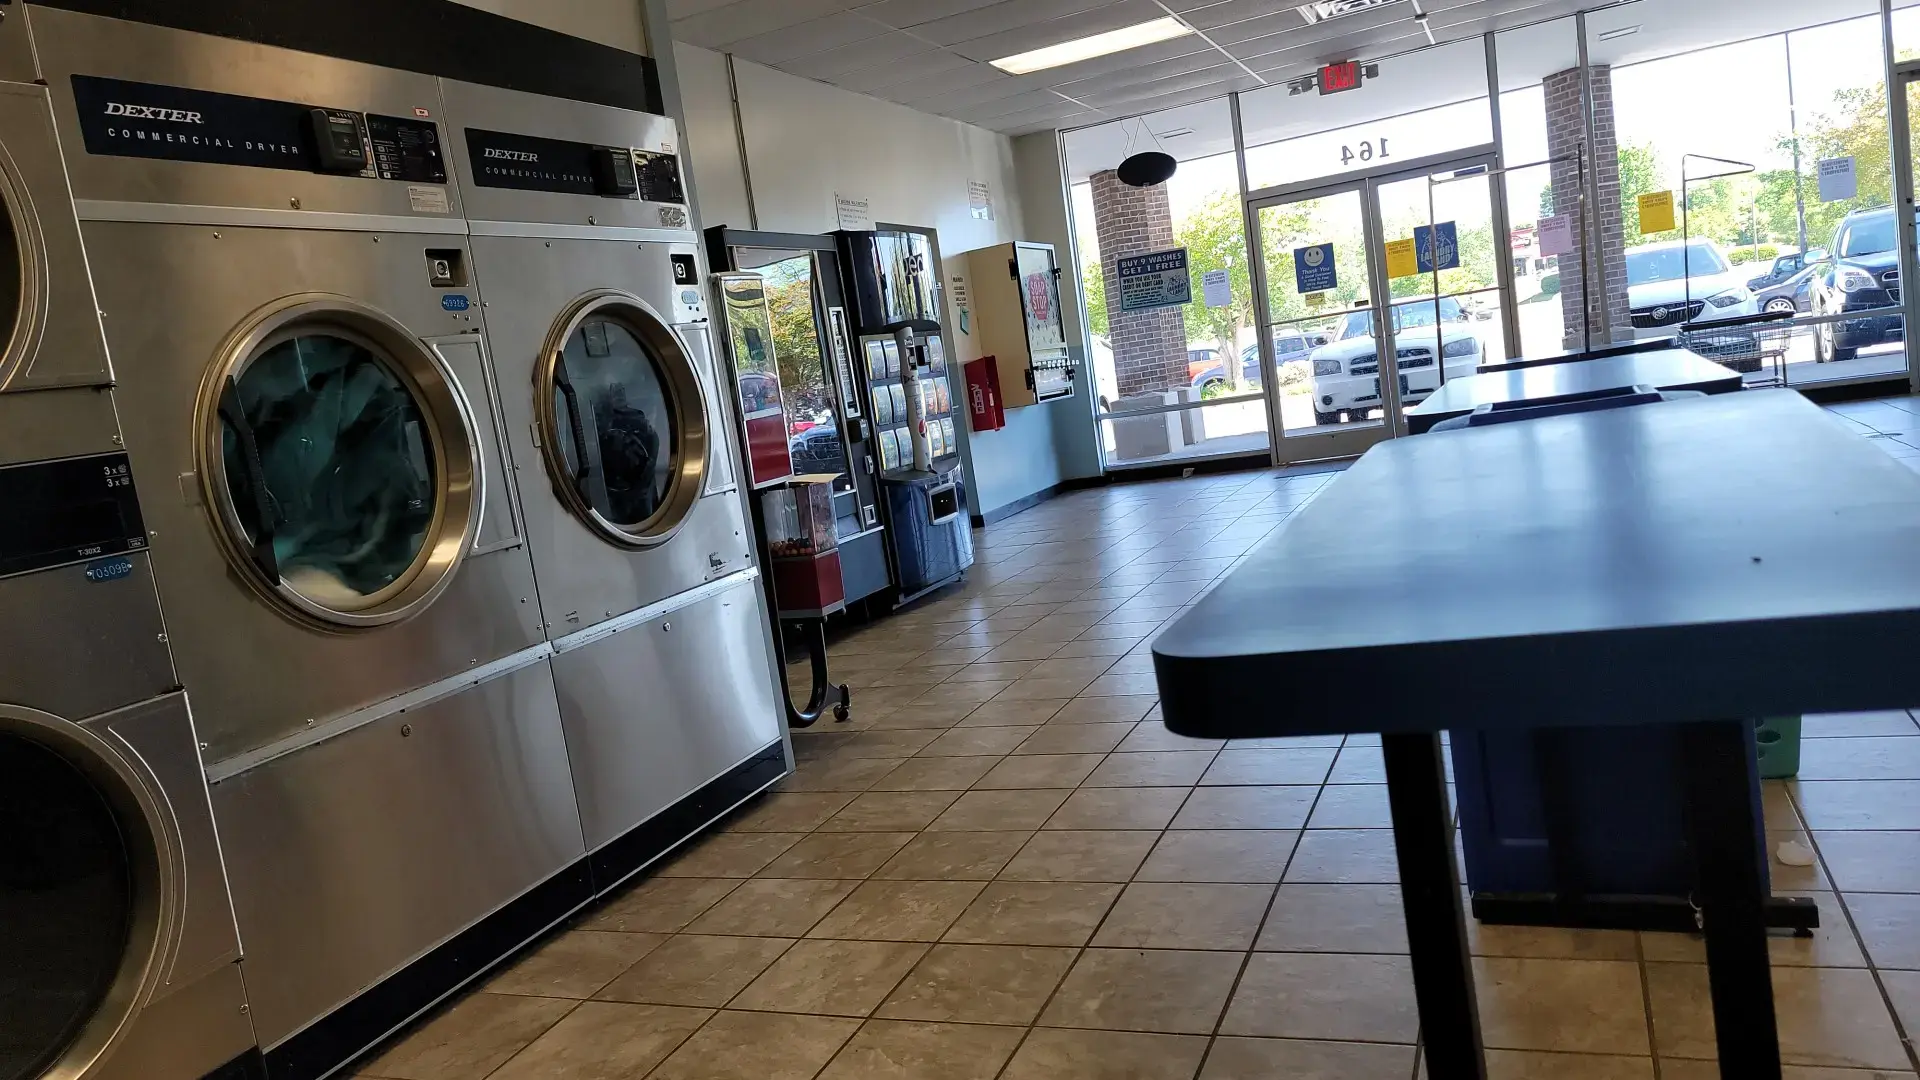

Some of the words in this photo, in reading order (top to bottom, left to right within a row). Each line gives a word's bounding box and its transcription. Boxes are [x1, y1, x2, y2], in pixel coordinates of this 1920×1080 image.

[1324, 63, 1355, 91] EXIT
[104, 102, 203, 124] DEXTER
[108, 128, 233, 148] COMMERCIAL
[246, 141, 298, 154] DRYER
[484, 148, 538, 162] DEXTER
[486, 166, 556, 180] COMMERCIAL
[1121, 259, 1138, 268] BUY
[1148, 252, 1182, 264] WASHES
[1122, 266, 1142, 275] GET
[1155, 260, 1181, 270] FREE
[1030, 281, 1045, 295] SOAP
[1032, 295, 1047, 310] STOP
[975, 390, 983, 411] FIRE
[103, 466, 110, 475] 3
[106, 478, 114, 487] 3
